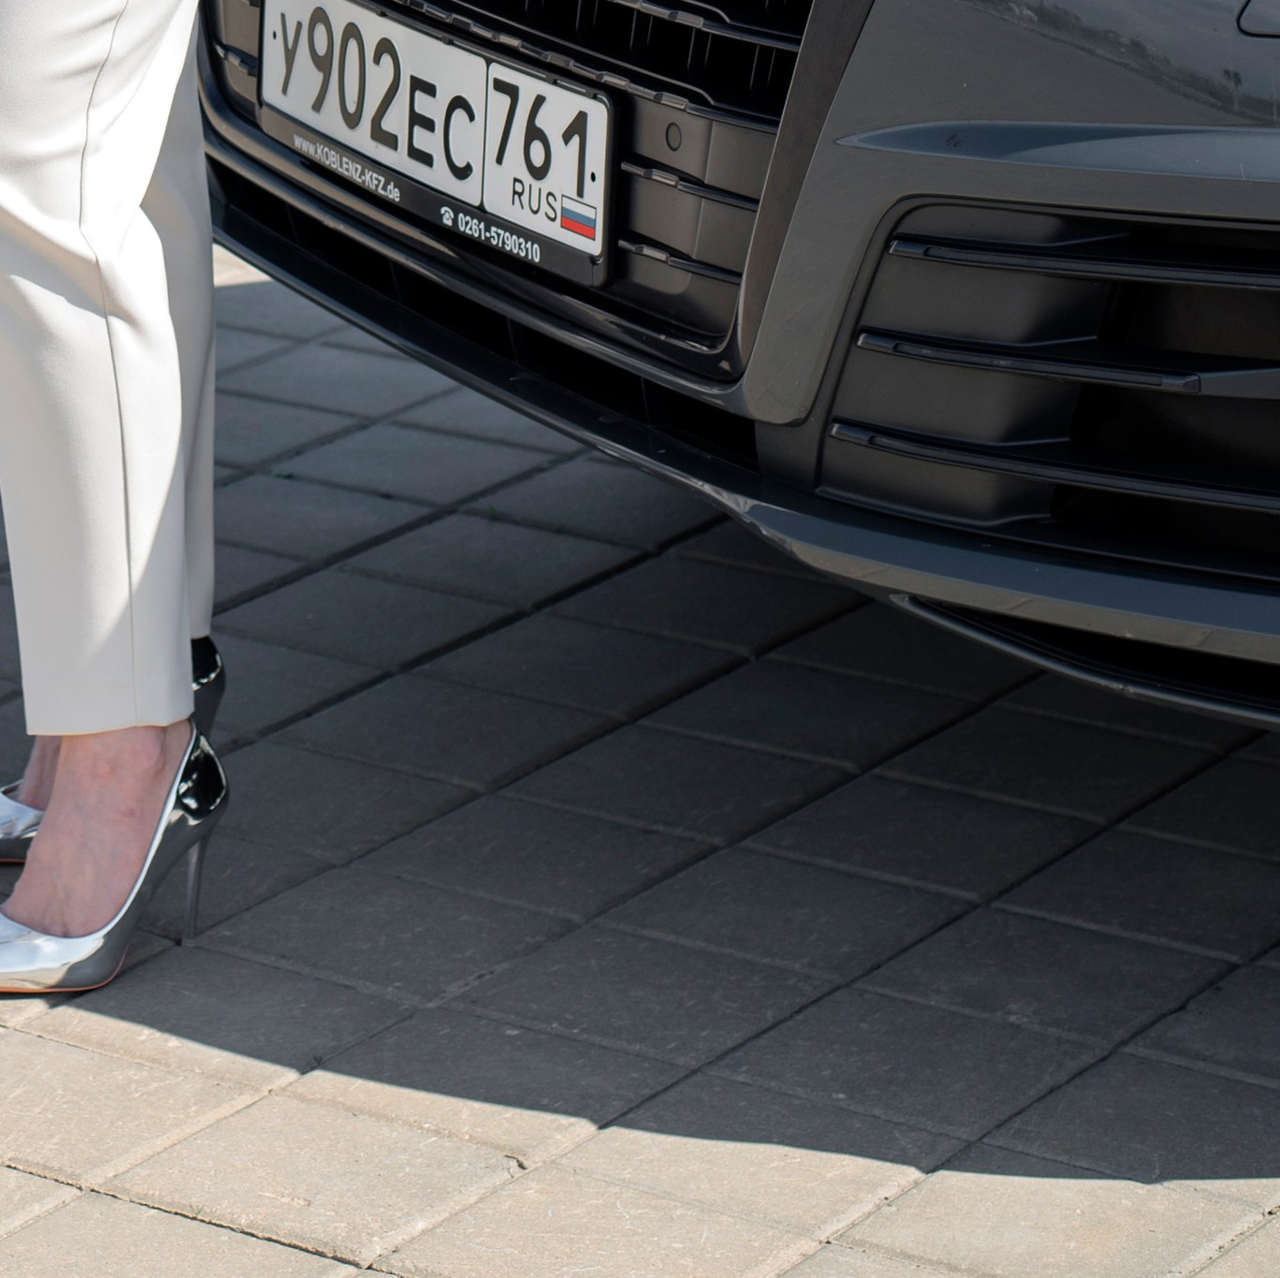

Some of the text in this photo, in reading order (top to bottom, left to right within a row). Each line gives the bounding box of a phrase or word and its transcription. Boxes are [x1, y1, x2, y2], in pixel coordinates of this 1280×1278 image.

[493, 78, 588, 198] 761
[293, 135, 400, 202] www.KOBLENZ-KFZ.de
[512, 176, 558, 223] RUS
[458, 212, 541, 263] 0261-5790310
